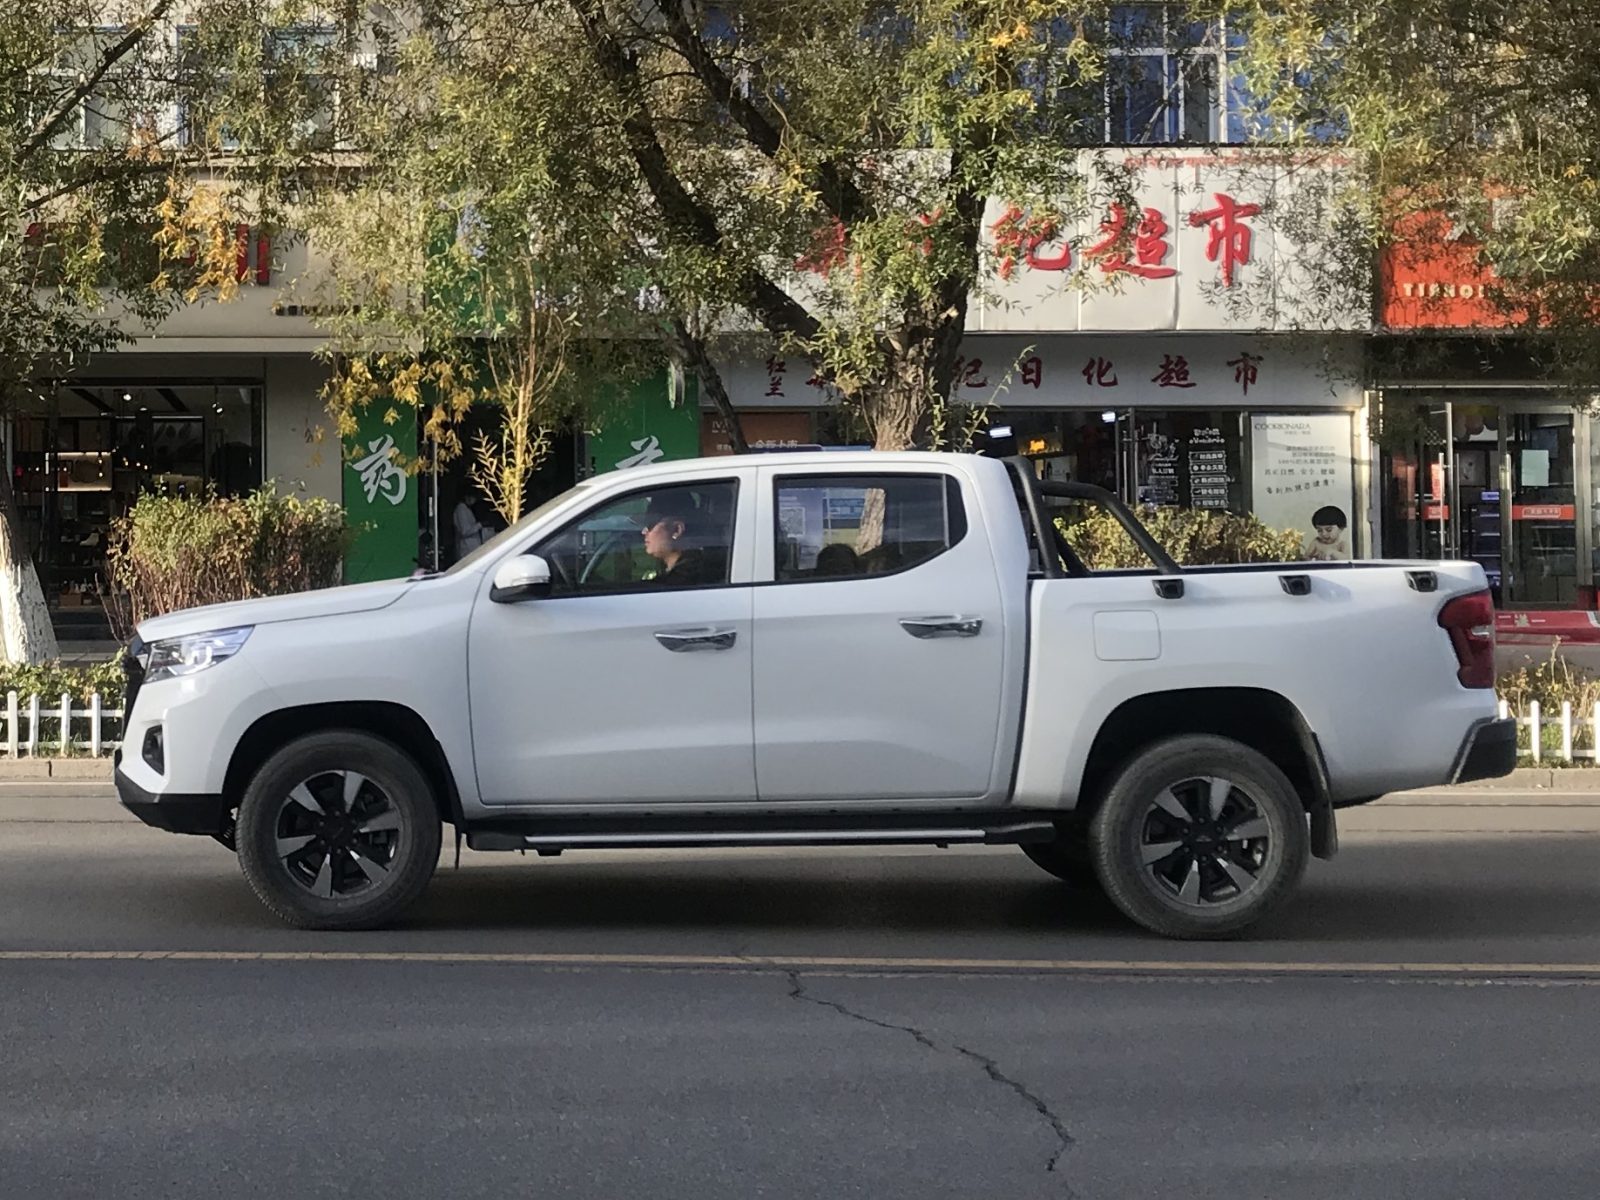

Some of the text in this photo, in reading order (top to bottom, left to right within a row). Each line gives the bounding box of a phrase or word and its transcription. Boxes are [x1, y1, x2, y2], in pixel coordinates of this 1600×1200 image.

[805, 352, 1264, 396] 纪日化超市
[351, 433, 407, 505] 药
